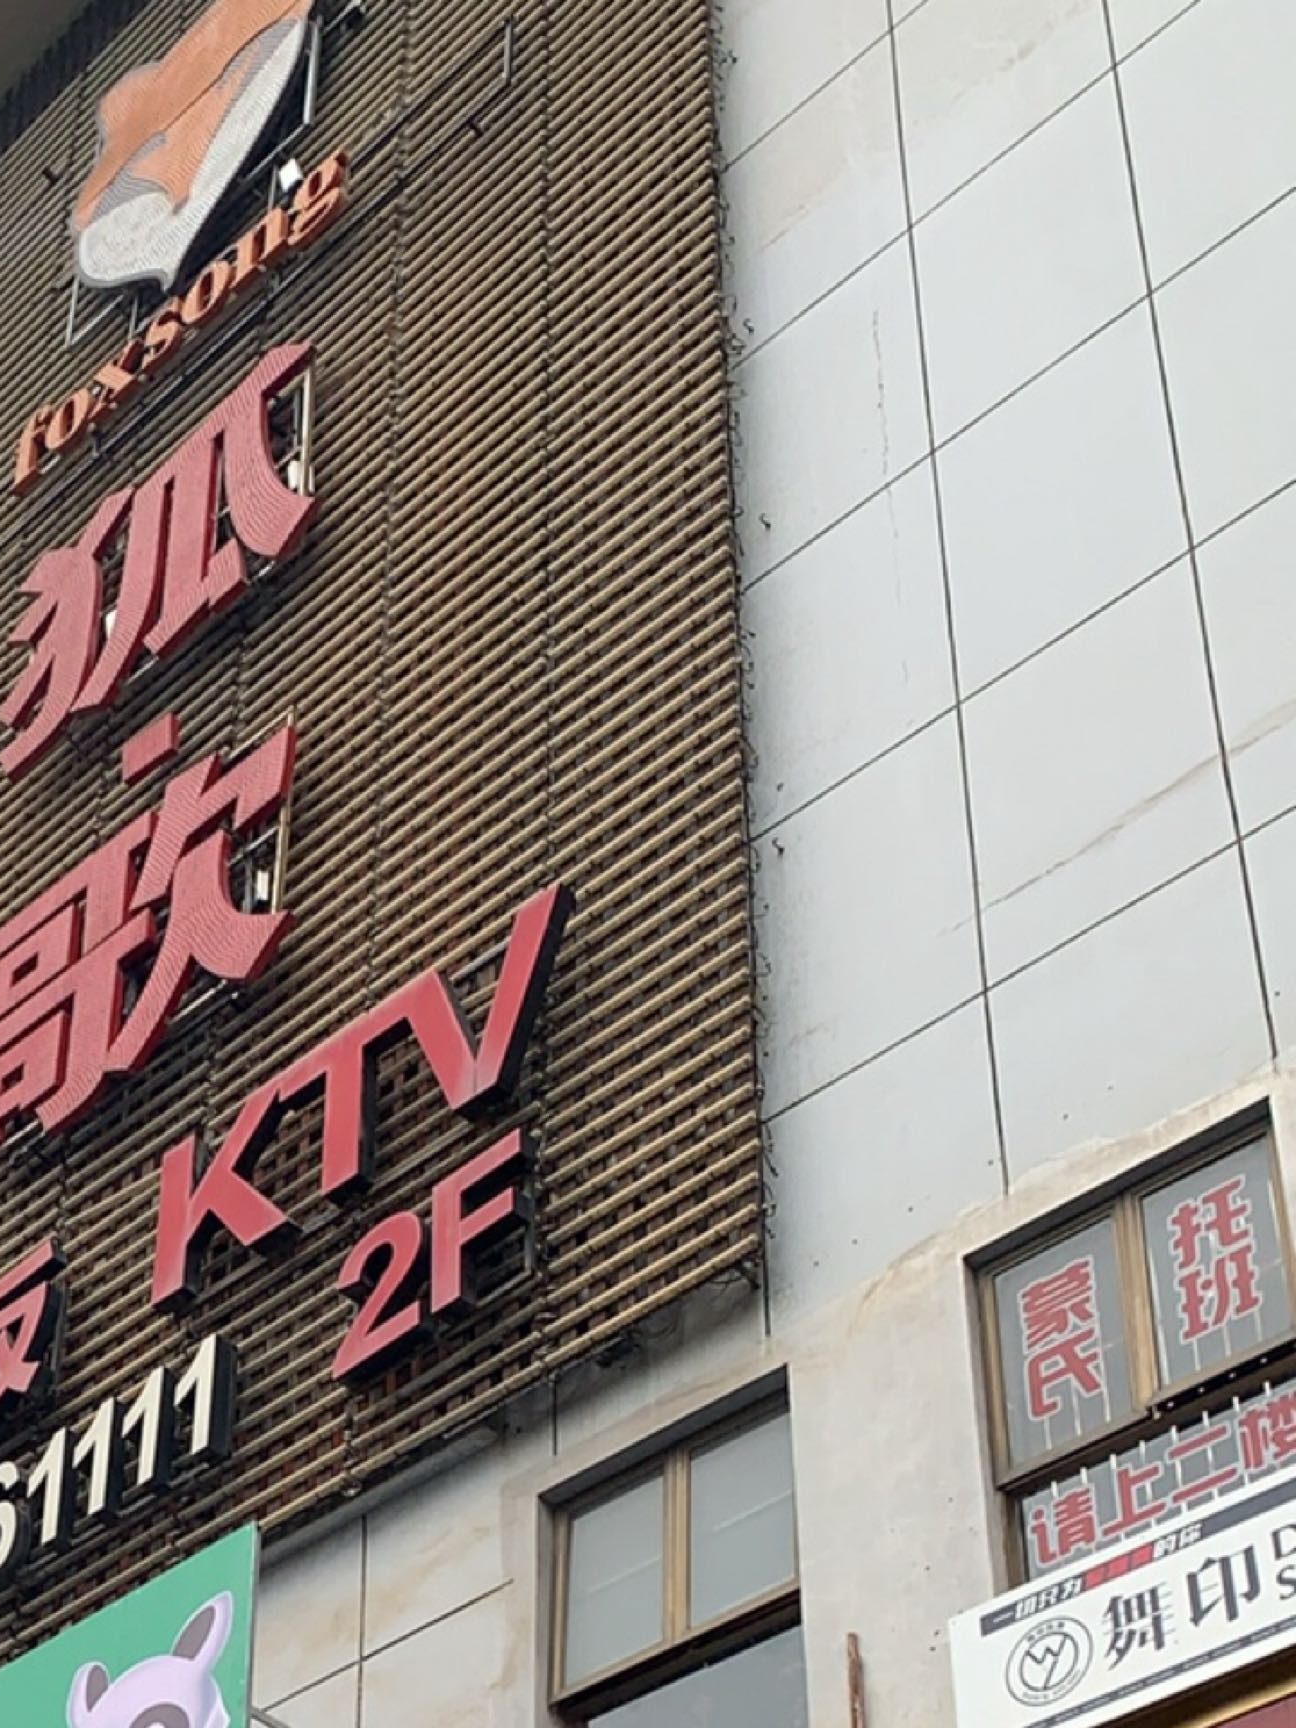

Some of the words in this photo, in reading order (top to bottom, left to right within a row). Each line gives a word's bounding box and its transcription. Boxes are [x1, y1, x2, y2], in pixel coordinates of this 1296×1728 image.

[151, 881, 576, 1311] KTV
[332, 1128, 534, 1385] 2F
[1169, 1175, 1262, 1342] 托班
